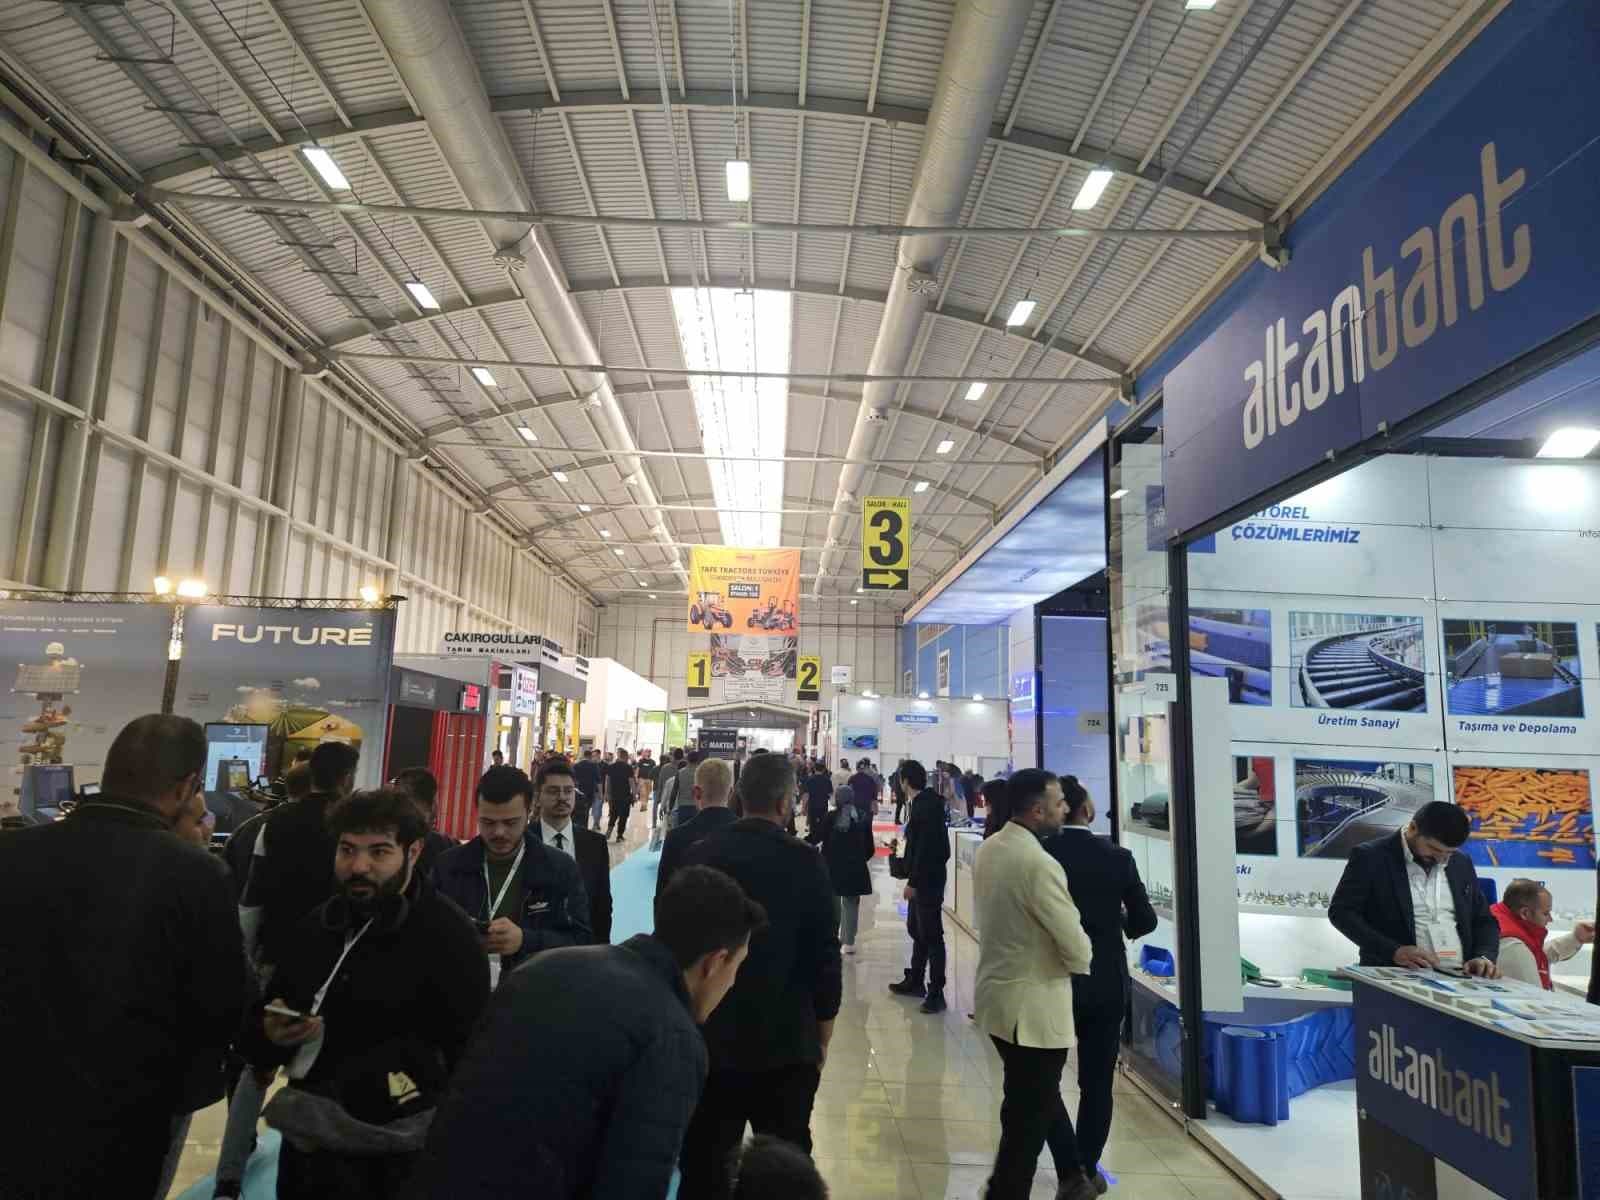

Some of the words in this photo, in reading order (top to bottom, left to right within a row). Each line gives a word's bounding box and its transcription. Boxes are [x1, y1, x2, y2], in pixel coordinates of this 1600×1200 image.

[1242, 141, 1531, 450] altanbant
[869, 510, 903, 566] 3
[1231, 522, 1360, 544] ÇÖZÜMLERİMİZ
[693, 659, 705, 686] 1
[800, 662, 817, 690] 2
[1318, 714, 1358, 726] Üretim
[1361, 716, 1400, 729] Sanayi
[1459, 720, 1498, 732] Taşıma
[1502, 723, 1516, 732] ve
[1520, 723, 1577, 735] Depolama
[1369, 1023, 1511, 1147] altanbant
